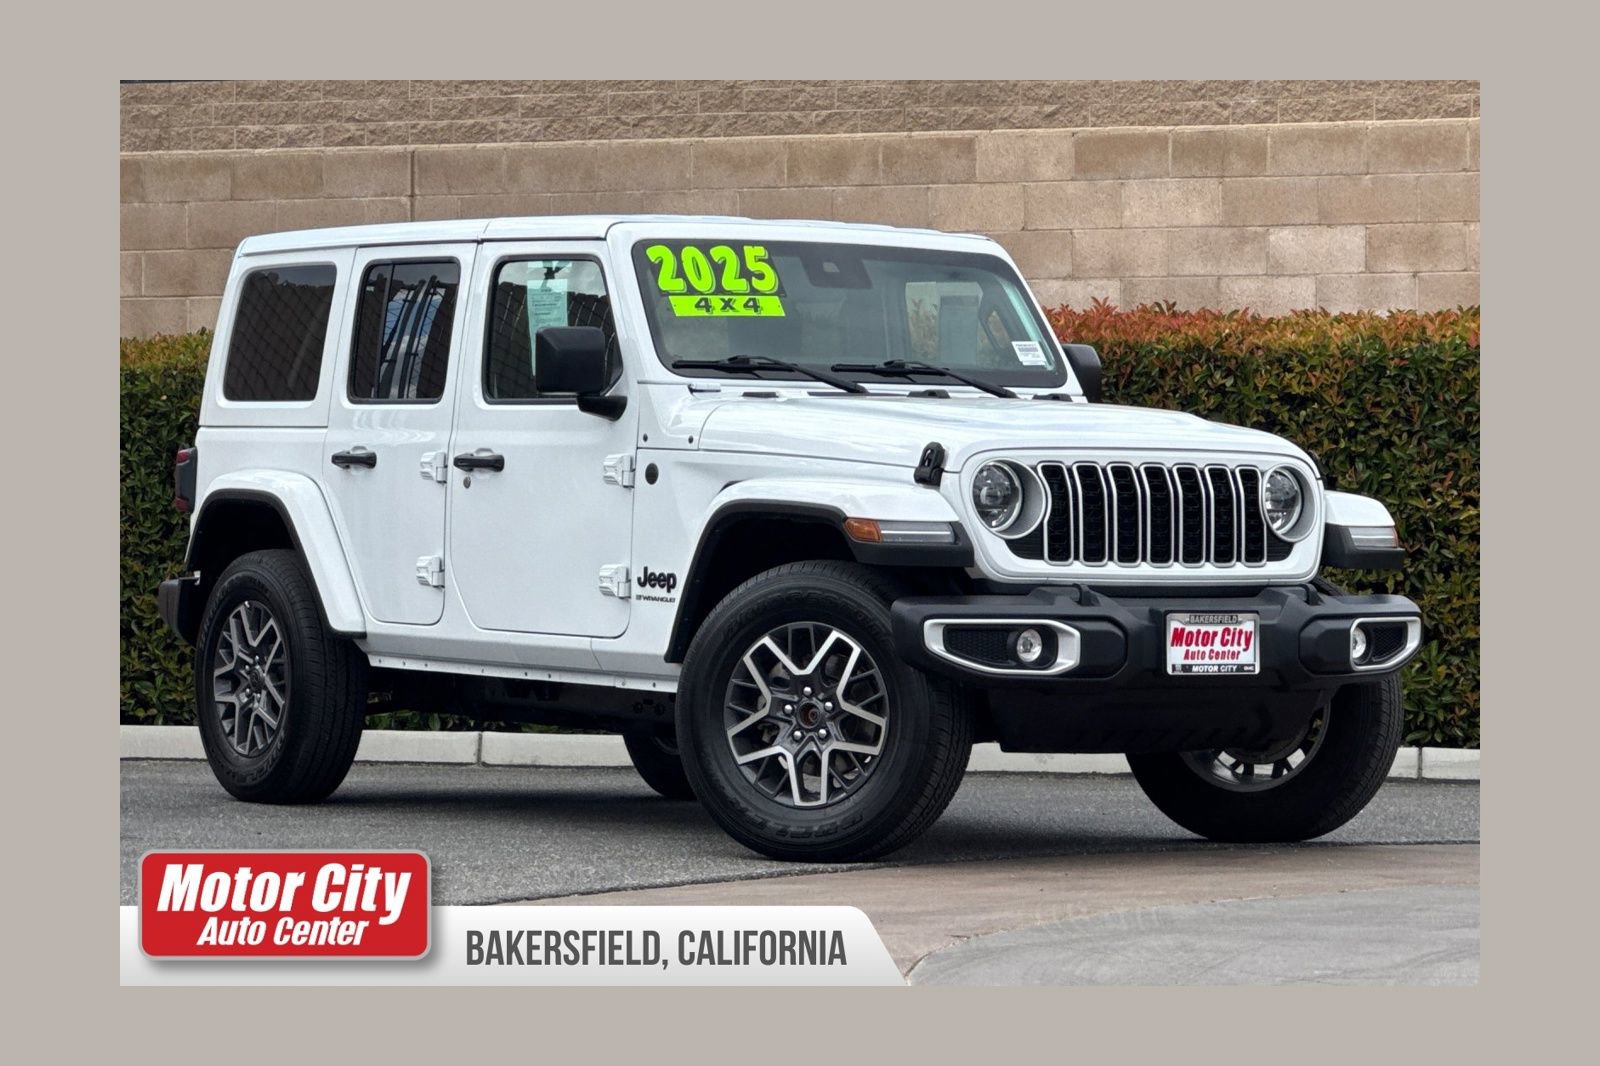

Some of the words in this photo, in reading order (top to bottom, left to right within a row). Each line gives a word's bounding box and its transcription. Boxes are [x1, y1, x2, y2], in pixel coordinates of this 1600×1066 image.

[646, 245, 778, 293] 2025
[637, 566, 677, 593] Jeep
[1190, 615, 1239, 624] BAKERSFIELD
[1171, 627, 1218, 647] Motor
[1220, 627, 1253, 652] City
[1184, 649, 1206, 661] Auto
[1208, 649, 1241, 661] Center
